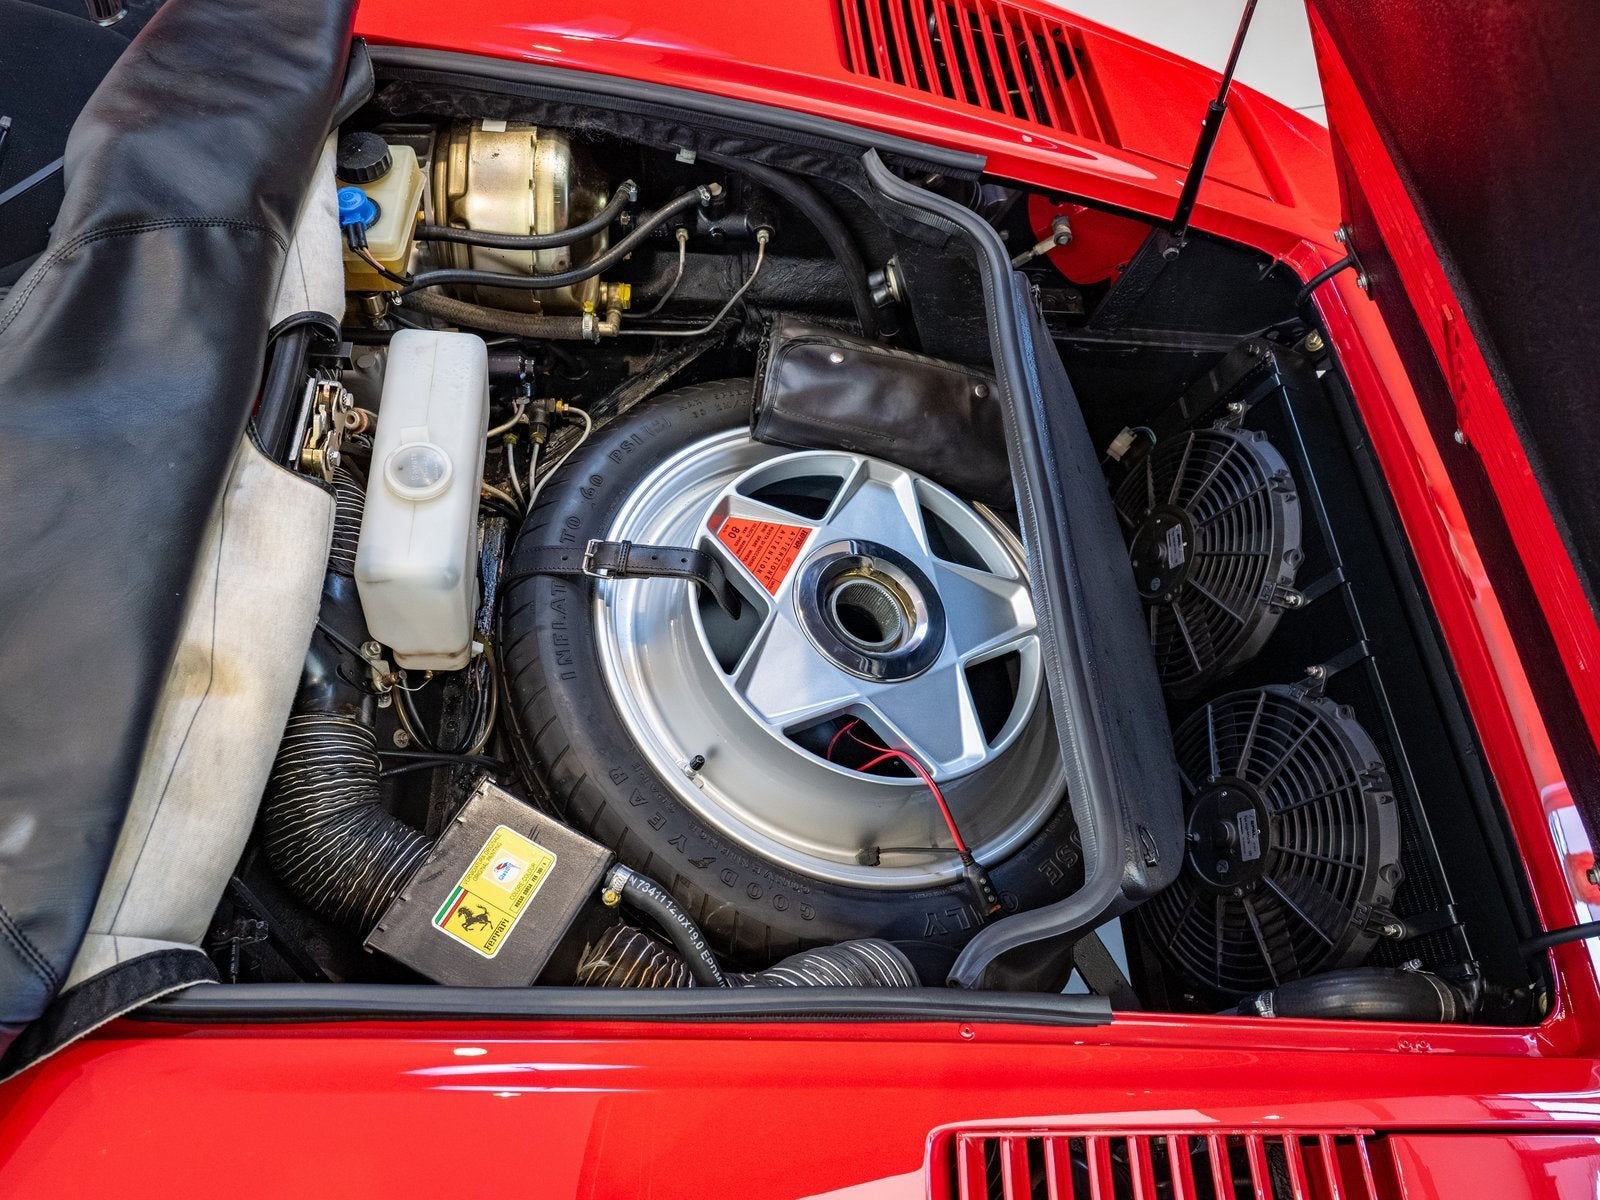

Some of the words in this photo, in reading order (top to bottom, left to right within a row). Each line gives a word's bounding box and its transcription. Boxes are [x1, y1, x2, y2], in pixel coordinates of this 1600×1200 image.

[608, 433, 645, 465] PSI
[580, 474, 604, 504] 60
[560, 516, 582, 544] TO
[728, 526, 740, 539] 80
[751, 534, 761, 547] SPARE
[746, 544, 763, 567] SOCCORSO
[757, 529, 786, 574] ATTENTION
[764, 531, 796, 580] ATTENZIONE
[551, 580, 577, 681] INFLAT
[514, 894, 525, 908] ROSSO
[636, 879, 667, 903] 73411
[484, 919, 509, 951] Ferrari
